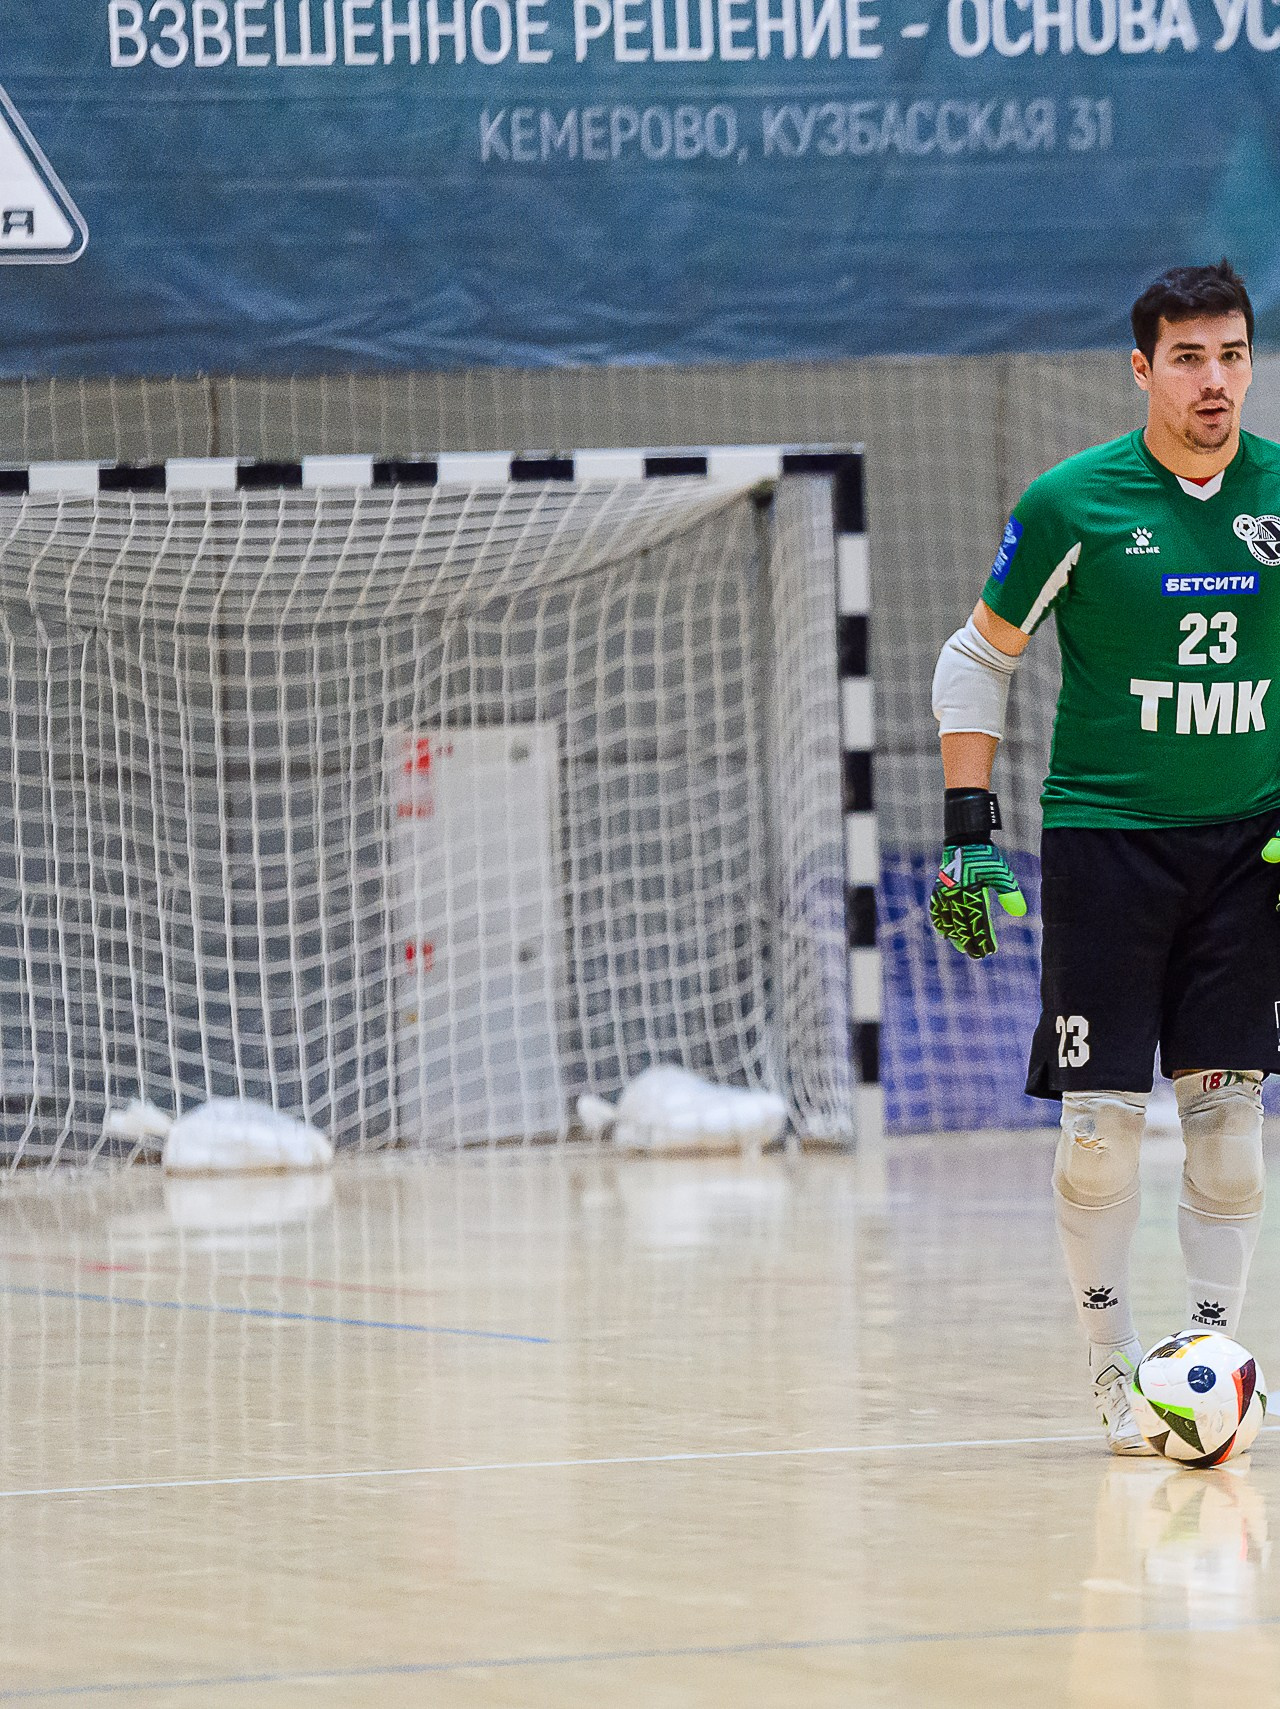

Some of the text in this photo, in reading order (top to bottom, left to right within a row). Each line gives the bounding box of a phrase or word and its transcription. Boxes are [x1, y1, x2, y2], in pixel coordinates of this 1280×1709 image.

[109, 0, 552, 66] ВЗВЕШЕННОЕ
[573, 0, 883, 62] РЕШЕНИЕ
[947, 0, 1199, 58] ОСНОВА
[479, 97, 1113, 166] КЕМЕРОВО, КУЗБАССКАЯ 31
[1125, 546, 1160, 555] KELME
[1165, 576, 1255, 592] БЕТСИТИ
[1178, 612, 1238, 666] 23
[1130, 679, 1272, 735] ТМК
[1055, 1015, 1090, 1068] 23
[1082, 1297, 1119, 1310] KELME
[1191, 1313, 1228, 1327] KELME
